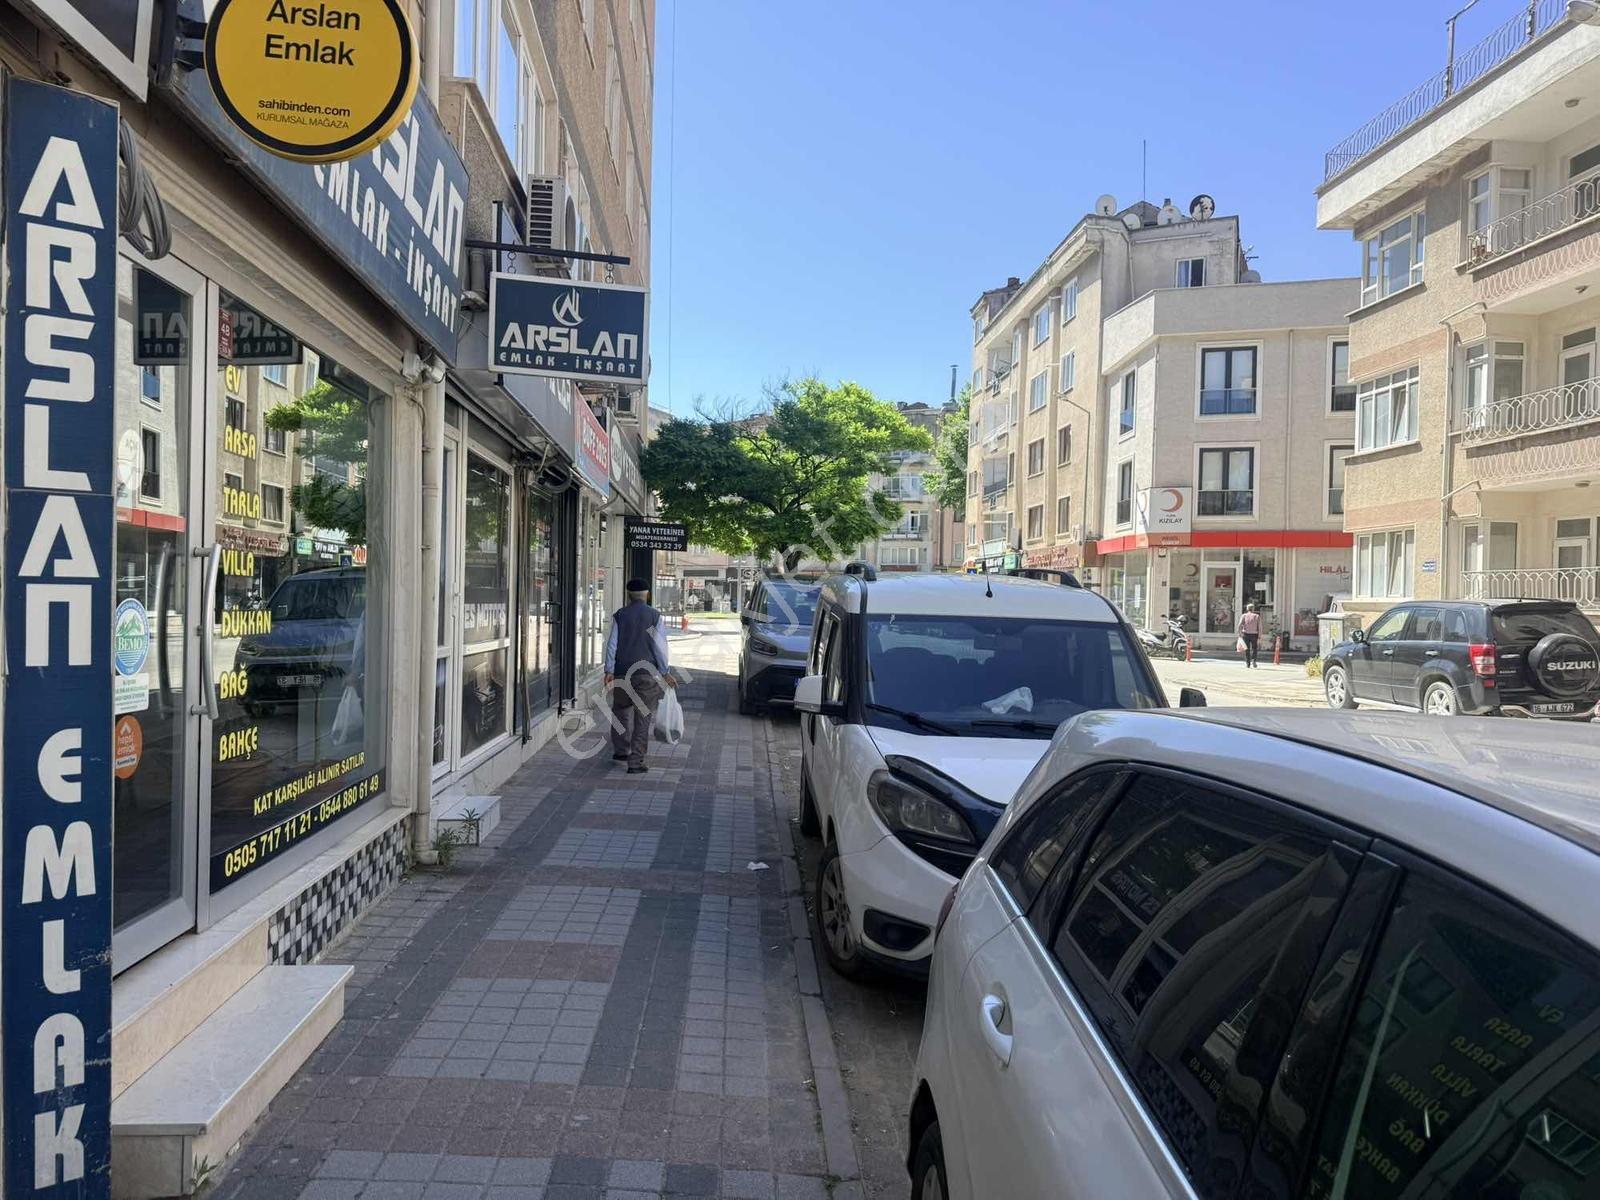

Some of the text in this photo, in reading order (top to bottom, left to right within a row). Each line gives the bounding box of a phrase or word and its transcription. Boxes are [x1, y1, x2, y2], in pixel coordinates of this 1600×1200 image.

[266, 0, 361, 31] Arslan
[264, 33, 356, 66] Emlak
[256, 112, 349, 129] KURUMSAL MAĞAZA
[258, 98, 351, 117] sahibinden.com
[372, 108, 464, 278] SLAN
[406, 226, 458, 333] İNŞAAT
[500, 322, 638, 360] ARSLAN
[225, 364, 241, 394] EV
[499, 351, 555, 367] EMLAK
[575, 355, 636, 374] İNŞAAT
[18, 135, 104, 667] ARSLAN
[224, 424, 256, 460] ARSA
[223, 486, 261, 519] TARLA
[630, 526, 651, 535] YANAR
[222, 543, 255, 577] VİLLA
[222, 605, 272, 637] DÜKKAN
[219, 663, 248, 700] BAĞ
[1546, 660, 1596, 671] SUZUKI
[219, 726, 258, 762] BAHÇE
[253, 751, 365, 816] KAT KARŞILIĞI ALINIR SATILIR
[224, 841, 257, 878] 0505
[260, 826, 281, 857] 717
[284, 818, 297, 843] 11
[299, 810, 312, 835] 21
[319, 796, 342, 824] 0544
[343, 789, 358, 809] 880
[359, 782, 368, 800] 61
[369, 777, 379, 792] 49
[21, 727, 97, 1190] EMLAK
